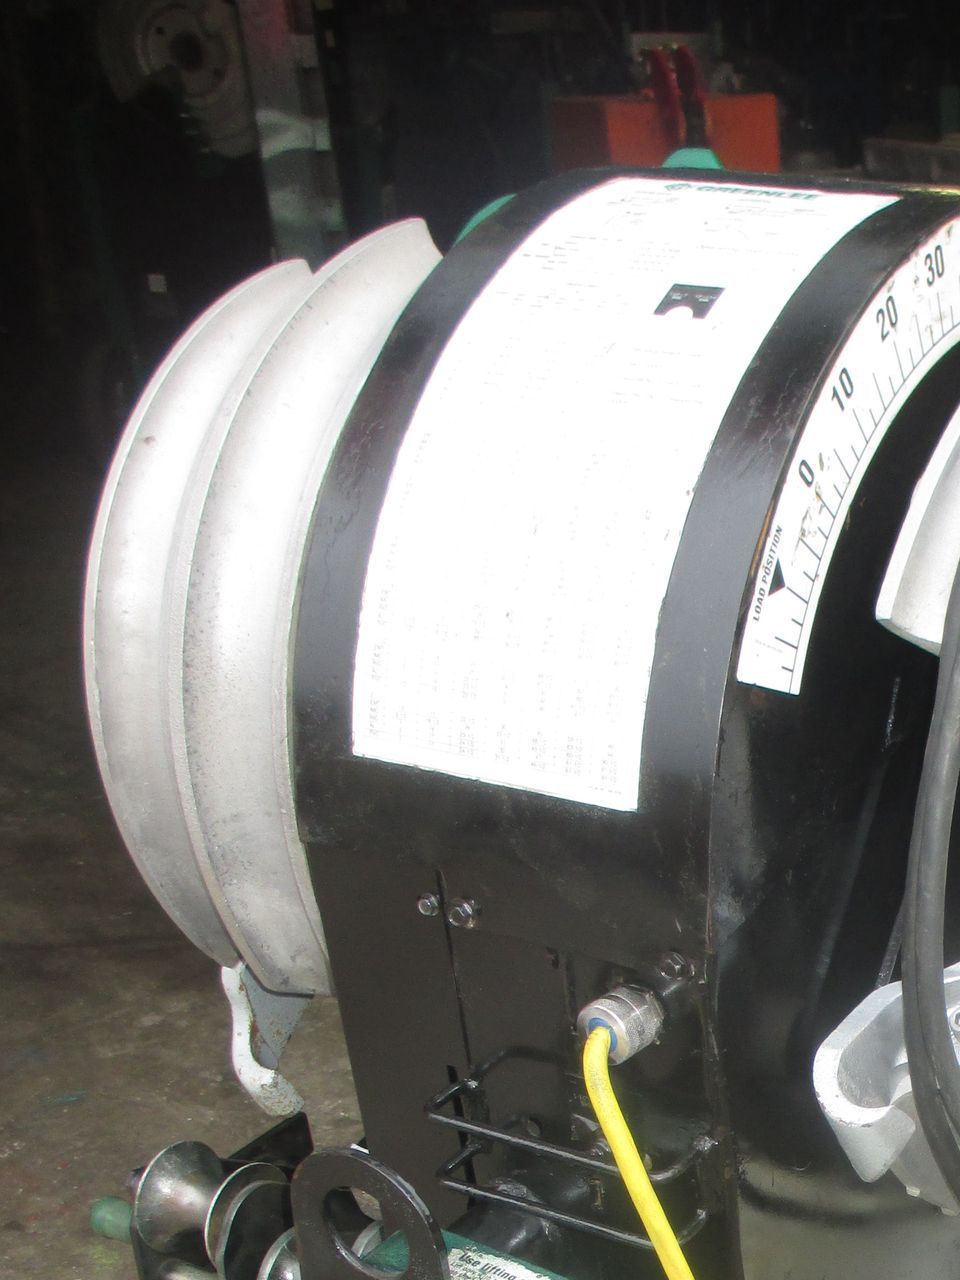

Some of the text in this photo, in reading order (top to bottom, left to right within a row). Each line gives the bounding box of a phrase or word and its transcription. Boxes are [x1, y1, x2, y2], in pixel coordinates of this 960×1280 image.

[924, 245, 945, 287] 30
[876, 295, 898, 343] 20
[831, 368, 854, 412] 10
[799, 459, 814, 488] 0
[753, 525, 783, 622] LOAD POSITION
[459, 1252, 481, 1267] Use
